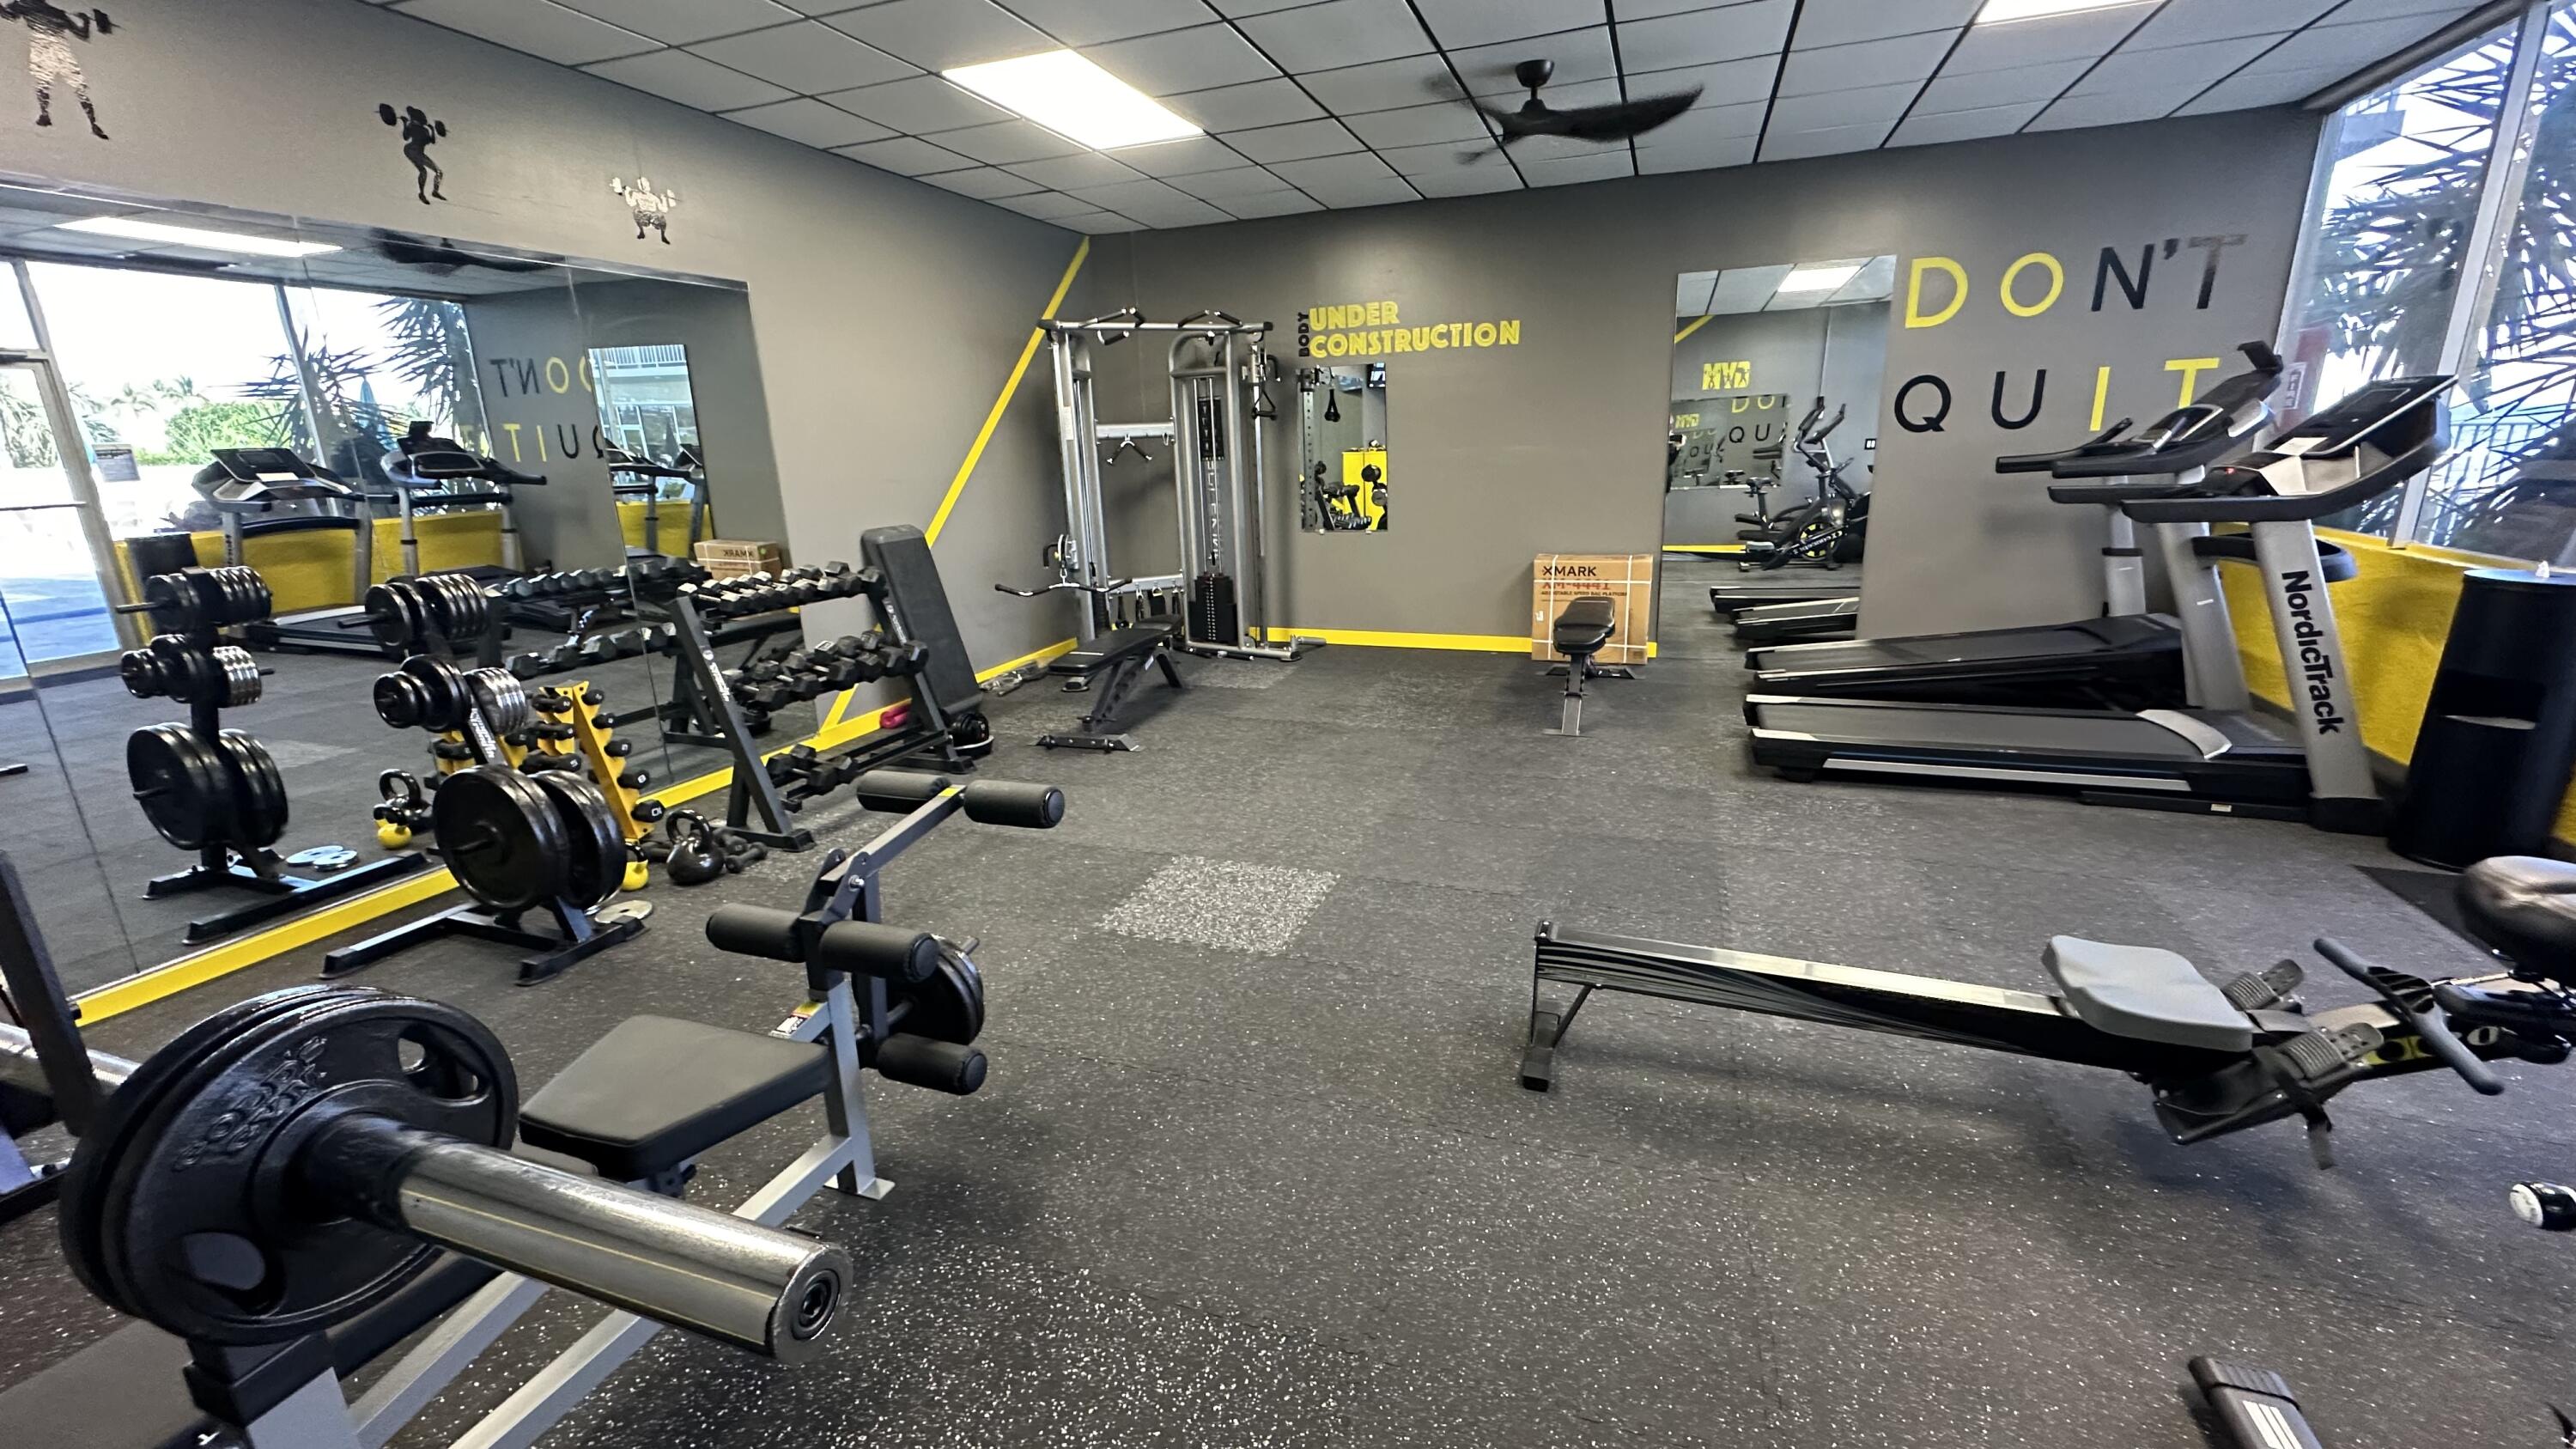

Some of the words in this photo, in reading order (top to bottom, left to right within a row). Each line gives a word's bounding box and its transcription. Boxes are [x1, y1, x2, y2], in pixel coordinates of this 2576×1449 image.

[1905, 234, 2248, 329] DON'T
[1297, 312, 1310, 357] BODY
[1309, 301, 1400, 331] UNDER
[1309, 320, 1521, 358] CONSTRUCTION
[1893, 356, 2221, 433] QUIT
[1542, 565, 1597, 577] XMARK
[2281, 569, 2346, 736] NordicTrack
